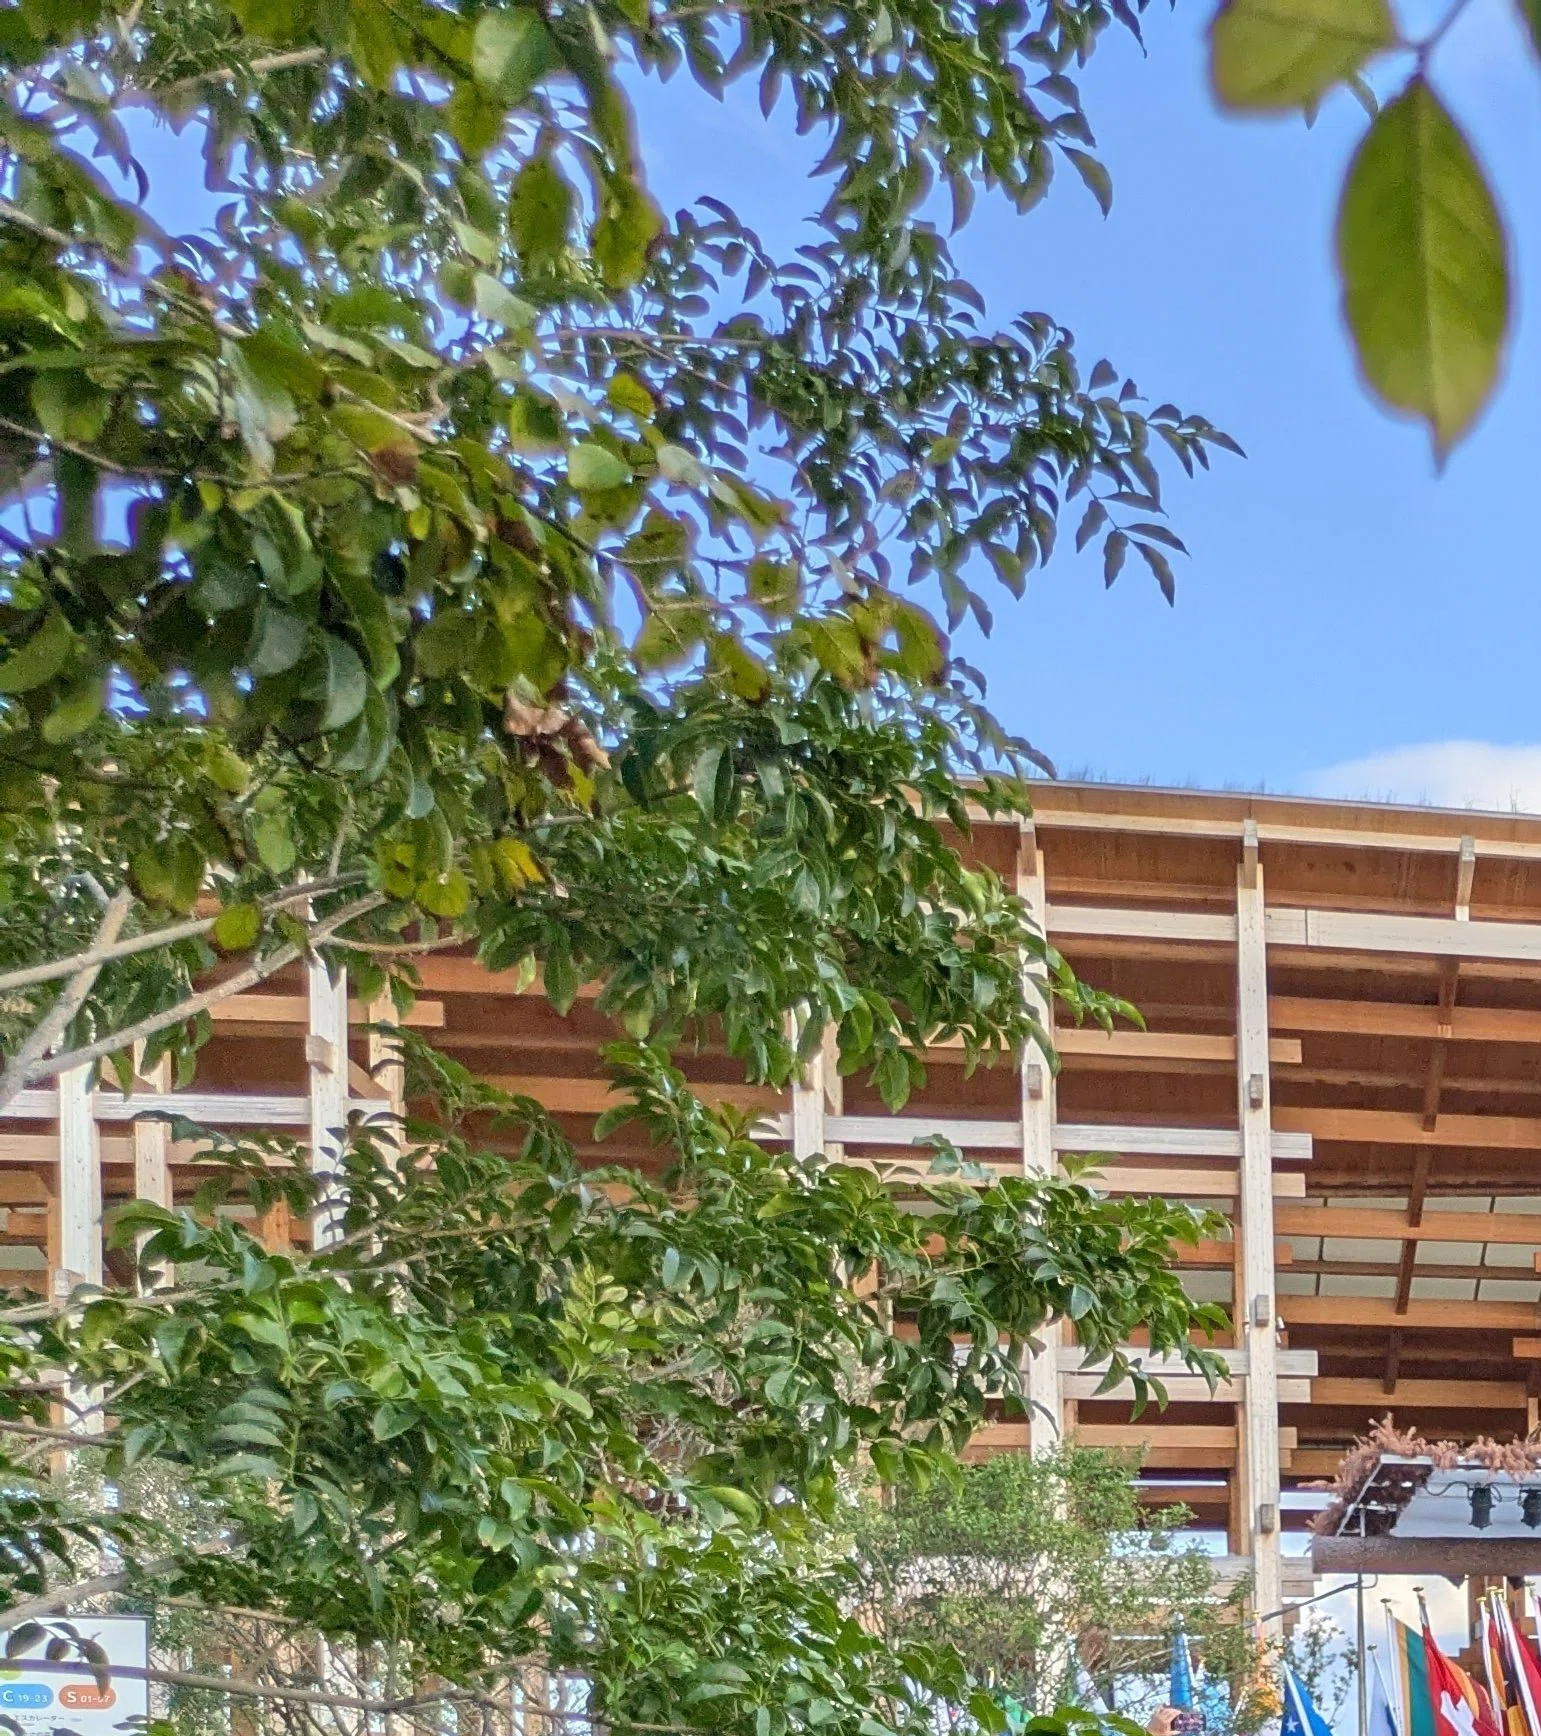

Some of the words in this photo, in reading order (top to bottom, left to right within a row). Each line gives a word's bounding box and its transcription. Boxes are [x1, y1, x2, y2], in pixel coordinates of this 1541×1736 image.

[3, 1690, 14, 1702] C
[18, 1694, 48, 1703] 19-23
[67, 1691, 77, 1703] S
